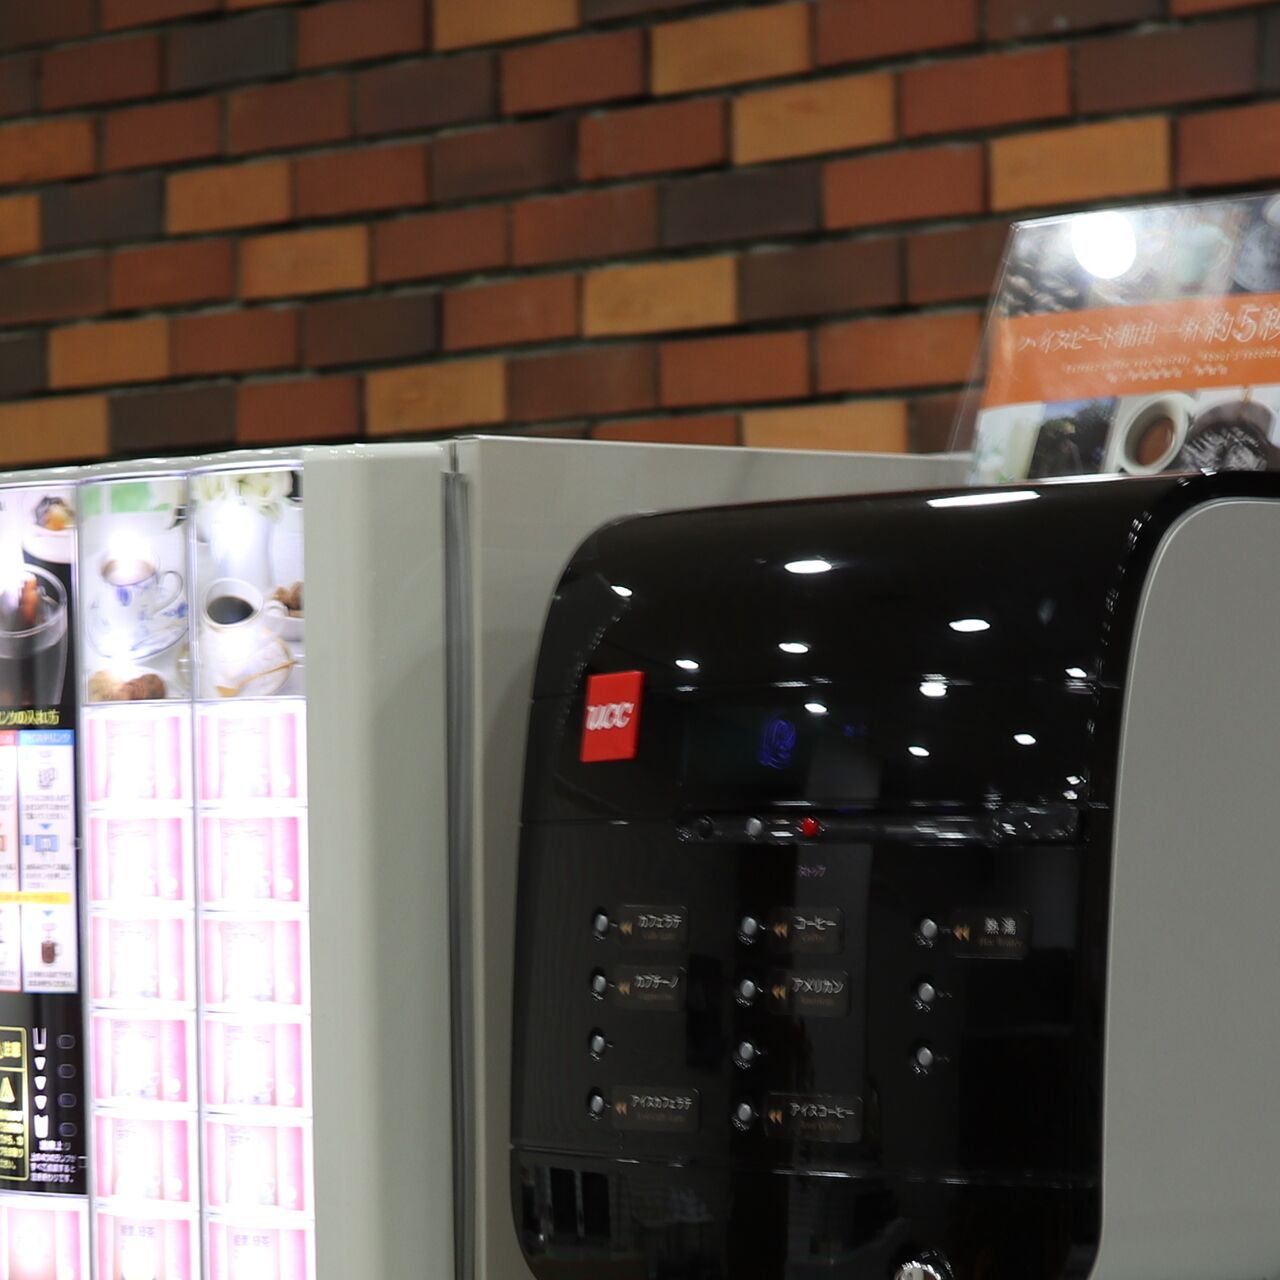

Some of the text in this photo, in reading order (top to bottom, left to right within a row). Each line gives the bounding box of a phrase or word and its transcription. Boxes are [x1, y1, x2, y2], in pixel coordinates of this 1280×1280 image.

[793, 915, 838, 931] コーヒー
[792, 976, 844, 994] アメリカン
[790, 1103, 855, 1119] アイスコーヒー
